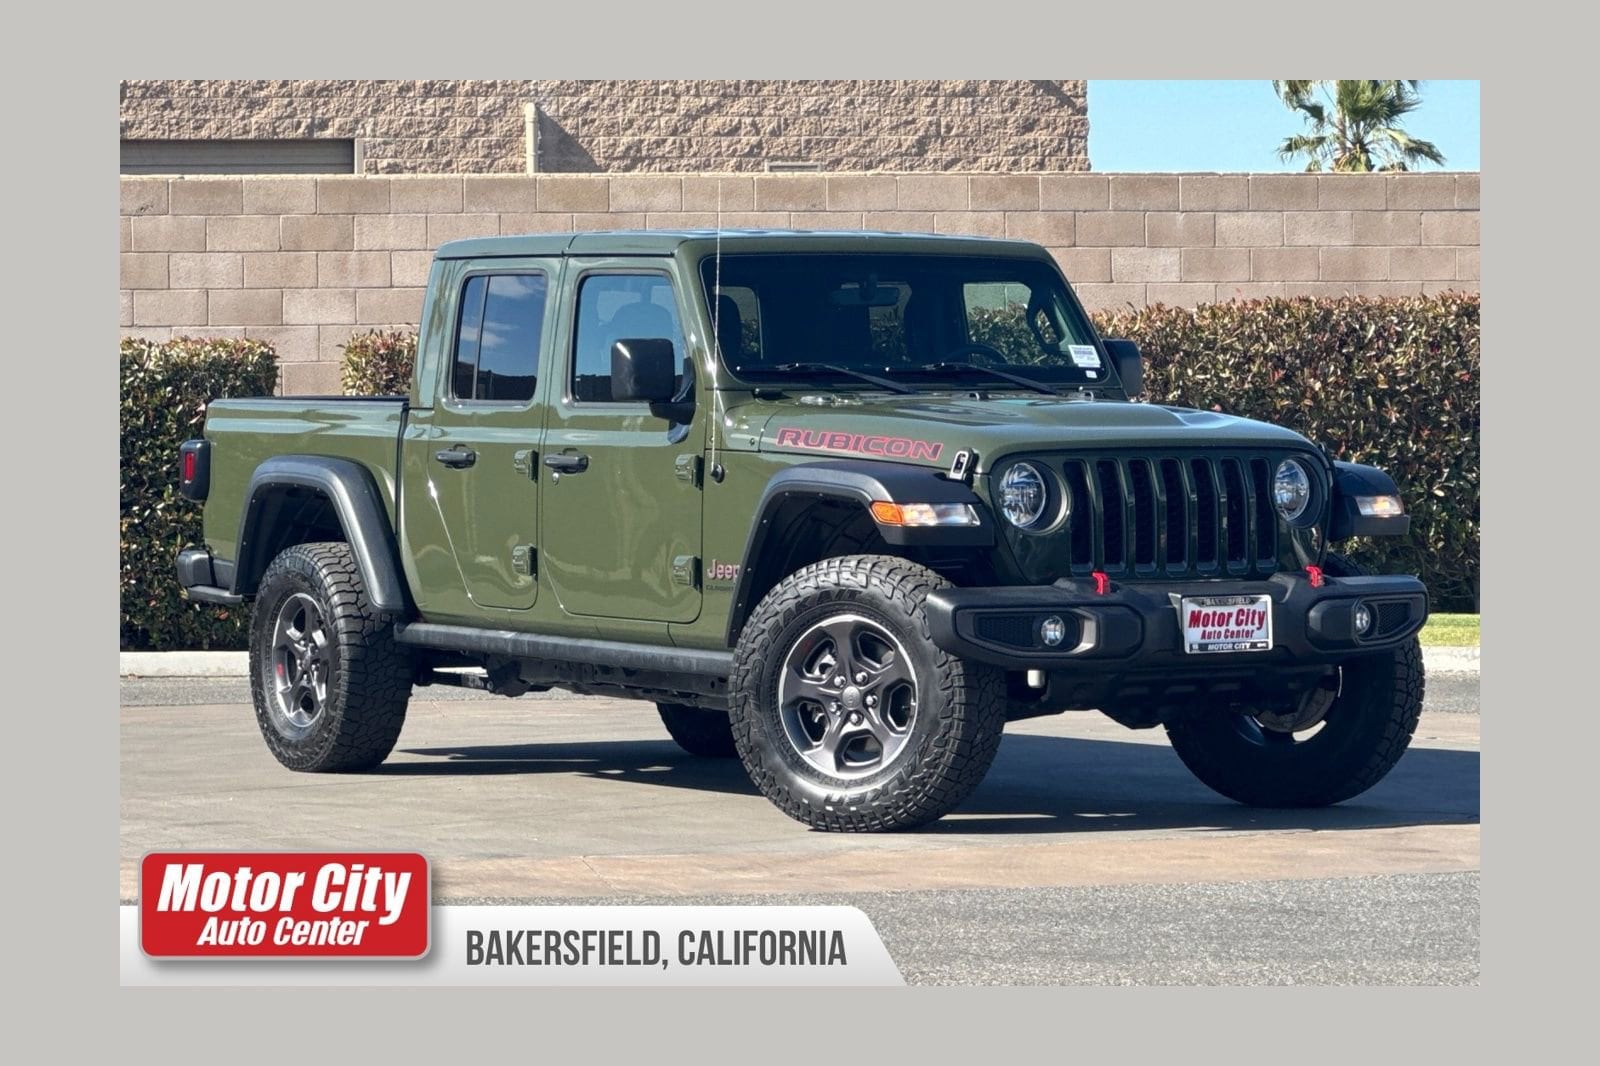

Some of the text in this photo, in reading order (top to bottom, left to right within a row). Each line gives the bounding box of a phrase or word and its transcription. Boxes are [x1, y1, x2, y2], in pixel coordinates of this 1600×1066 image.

[776, 427, 944, 461] RUBICON
[707, 559, 741, 583] Jeep
[1206, 597, 1251, 605] BASFIELD
[1188, 608, 1266, 630] Motor City
[1201, 628, 1254, 640] Auto Center
